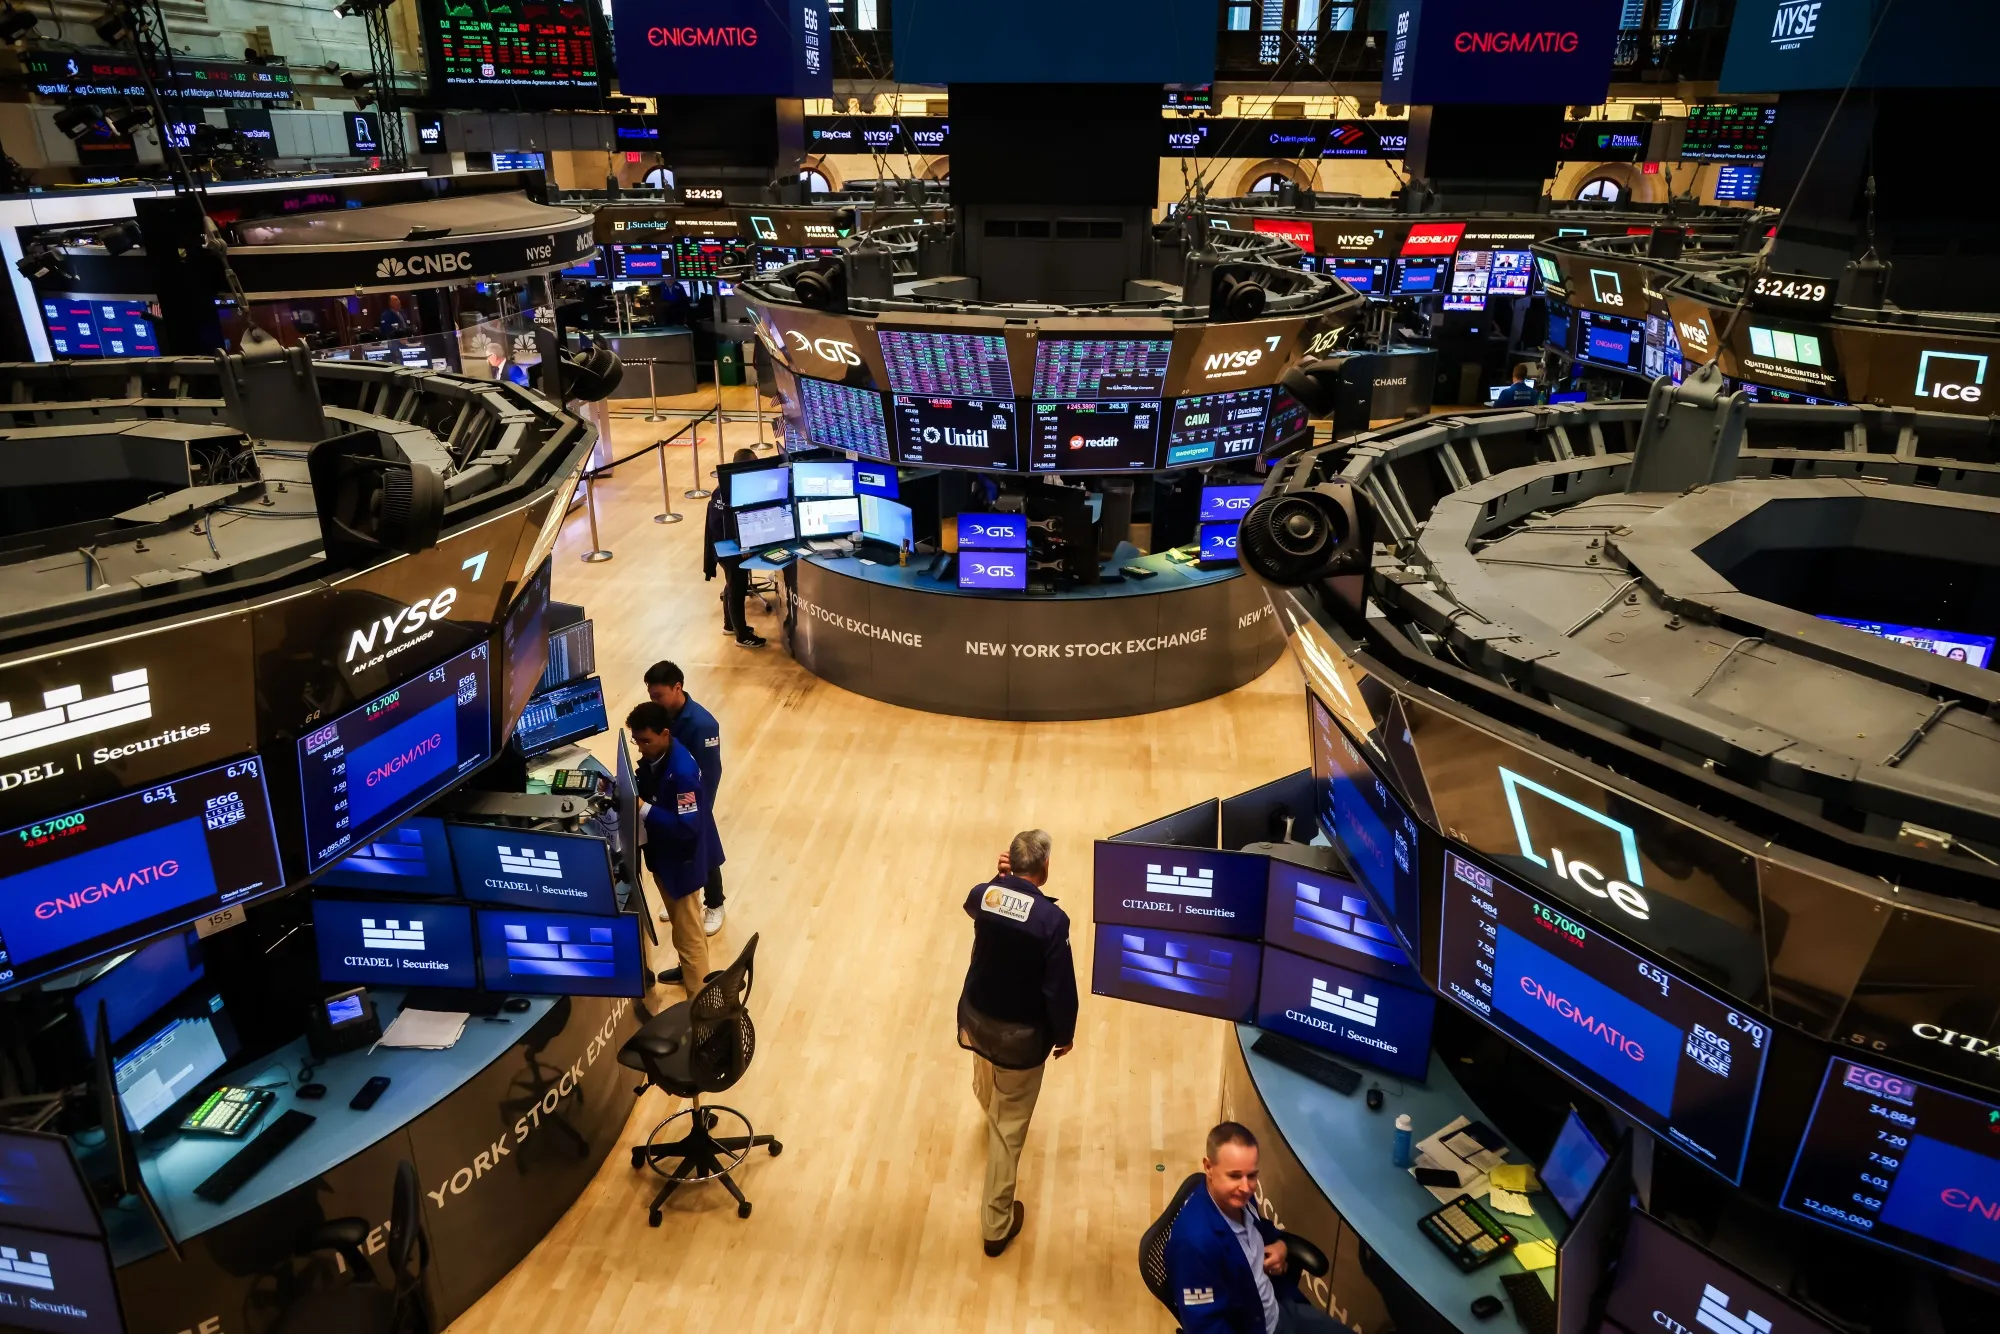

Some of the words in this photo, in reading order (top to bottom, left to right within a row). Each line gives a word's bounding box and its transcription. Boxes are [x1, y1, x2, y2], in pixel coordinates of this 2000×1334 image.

[804, 7, 818, 30] EGG
[1396, 11, 1410, 35] EGG
[1771, 2, 1822, 38] NYSE
[805, 35, 819, 47] LISTED
[190, 88, 215, 99] Michigan
[821, 130, 852, 140] BayCrest
[684, 188, 723, 199] 3:24:29
[626, 220, 669, 230] J.Streicher
[804, 225, 835, 233] VIRTU
[1407, 234, 1458, 245] ROSENBLATT
[407, 251, 473, 276] CNBC
[1753, 277, 1827, 302] 3:24:29
[814, 337, 862, 366] GTS
[1743, 358, 1775, 371] QUATTRO
[1775, 365, 1783, 373] M
[1783, 366, 1820, 380] SECURITIES
[1820, 373, 1837, 382] INC.
[898, 396, 911, 404] UTL
[1184, 412, 1210, 427] CAVA
[943, 426, 989, 448] Unitil
[1085, 436, 1119, 448] reddit
[1223, 437, 1256, 453] YETI
[1175, 446, 1209, 458] sweetgreen
[809, 603, 844, 629] STOCK
[846, 617, 923, 649] EXCHANGE
[1237, 611, 1262, 629] NEW
[965, 640, 1007, 657] NEW
[1010, 643, 1061, 659] YORK
[1064, 640, 1122, 657] STOCK
[1126, 627, 1208, 654] EXCHANGE
[351, 659, 369, 676] AN
[371, 690, 401, 714] 6.7000
[428, 666, 446, 684] 6.51
[470, 644, 487, 660] 6.70
[458, 672, 476, 687] EGG
[457, 687, 478, 704] NYSE
[92, 718, 212, 767] Securities
[305, 725, 332, 750] EGG
[322, 743, 345, 763] 34,884
[0, 761, 65, 792] DEL
[331, 762, 346, 776] 7.20
[332, 780, 347, 794] 7.50
[30, 812, 86, 838] 6.7000
[142, 785, 176, 805] 6.51
[226, 760, 257, 778] 6.70
[206, 791, 240, 810] EGG
[334, 798, 348, 812] 6.01
[205, 801, 245, 819] LISTED
[206, 808, 247, 830] NYSE
[335, 815, 349, 829] 6.62
[318, 832, 351, 860] 12,095,000
[1454, 860, 1487, 888] EGG
[220, 887, 240, 901] Citadel
[238, 880, 264, 896] Securities
[484, 878, 533, 894] CITADEL
[541, 884, 589, 899] Securities
[1001, 893, 1031, 914] TJM
[1122, 898, 1174, 913] CITADEL
[1185, 904, 1236, 918] Securities
[1470, 894, 1499, 917] 34,884
[206, 909, 234, 928] 155
[1478, 919, 1497, 936] 7.20
[1477, 939, 1496, 956] 7.50
[343, 956, 393, 969] CITADEL
[402, 958, 449, 972] Securities
[1475, 959, 1494, 976] 6.01
[1541, 907, 1587, 941] 6.7000
[1637, 961, 1671, 990] 6.51
[1726, 1011, 1764, 1041] 6.70
[1474, 978, 1492, 995] 6.62
[1449, 981, 1492, 1014] 12,095,000
[1285, 1008, 1337, 1034] CITADEL
[1346, 1028, 1399, 1054] Securities
[1692, 1022, 1731, 1053] EGG
[1685, 1042, 1731, 1077] NYSE
[1687, 1034, 1733, 1065] LISTED
[1847, 1064, 1904, 1097] EGG
[514, 1056, 585, 1144] STOCK
[1868, 1103, 1917, 1127] 34,884
[1688, 1138, 1718, 1161] Securities
[1877, 1130, 1908, 1148] 7.20
[1868, 1151, 1899, 1169] 7.50
[427, 1133, 511, 1210] YORK
[1860, 1172, 1890, 1190] 6.01
[1852, 1192, 1883, 1210] 6.62
[1802, 1197, 1874, 1230] 12,095,000
[29, 1297, 88, 1319] Securities
